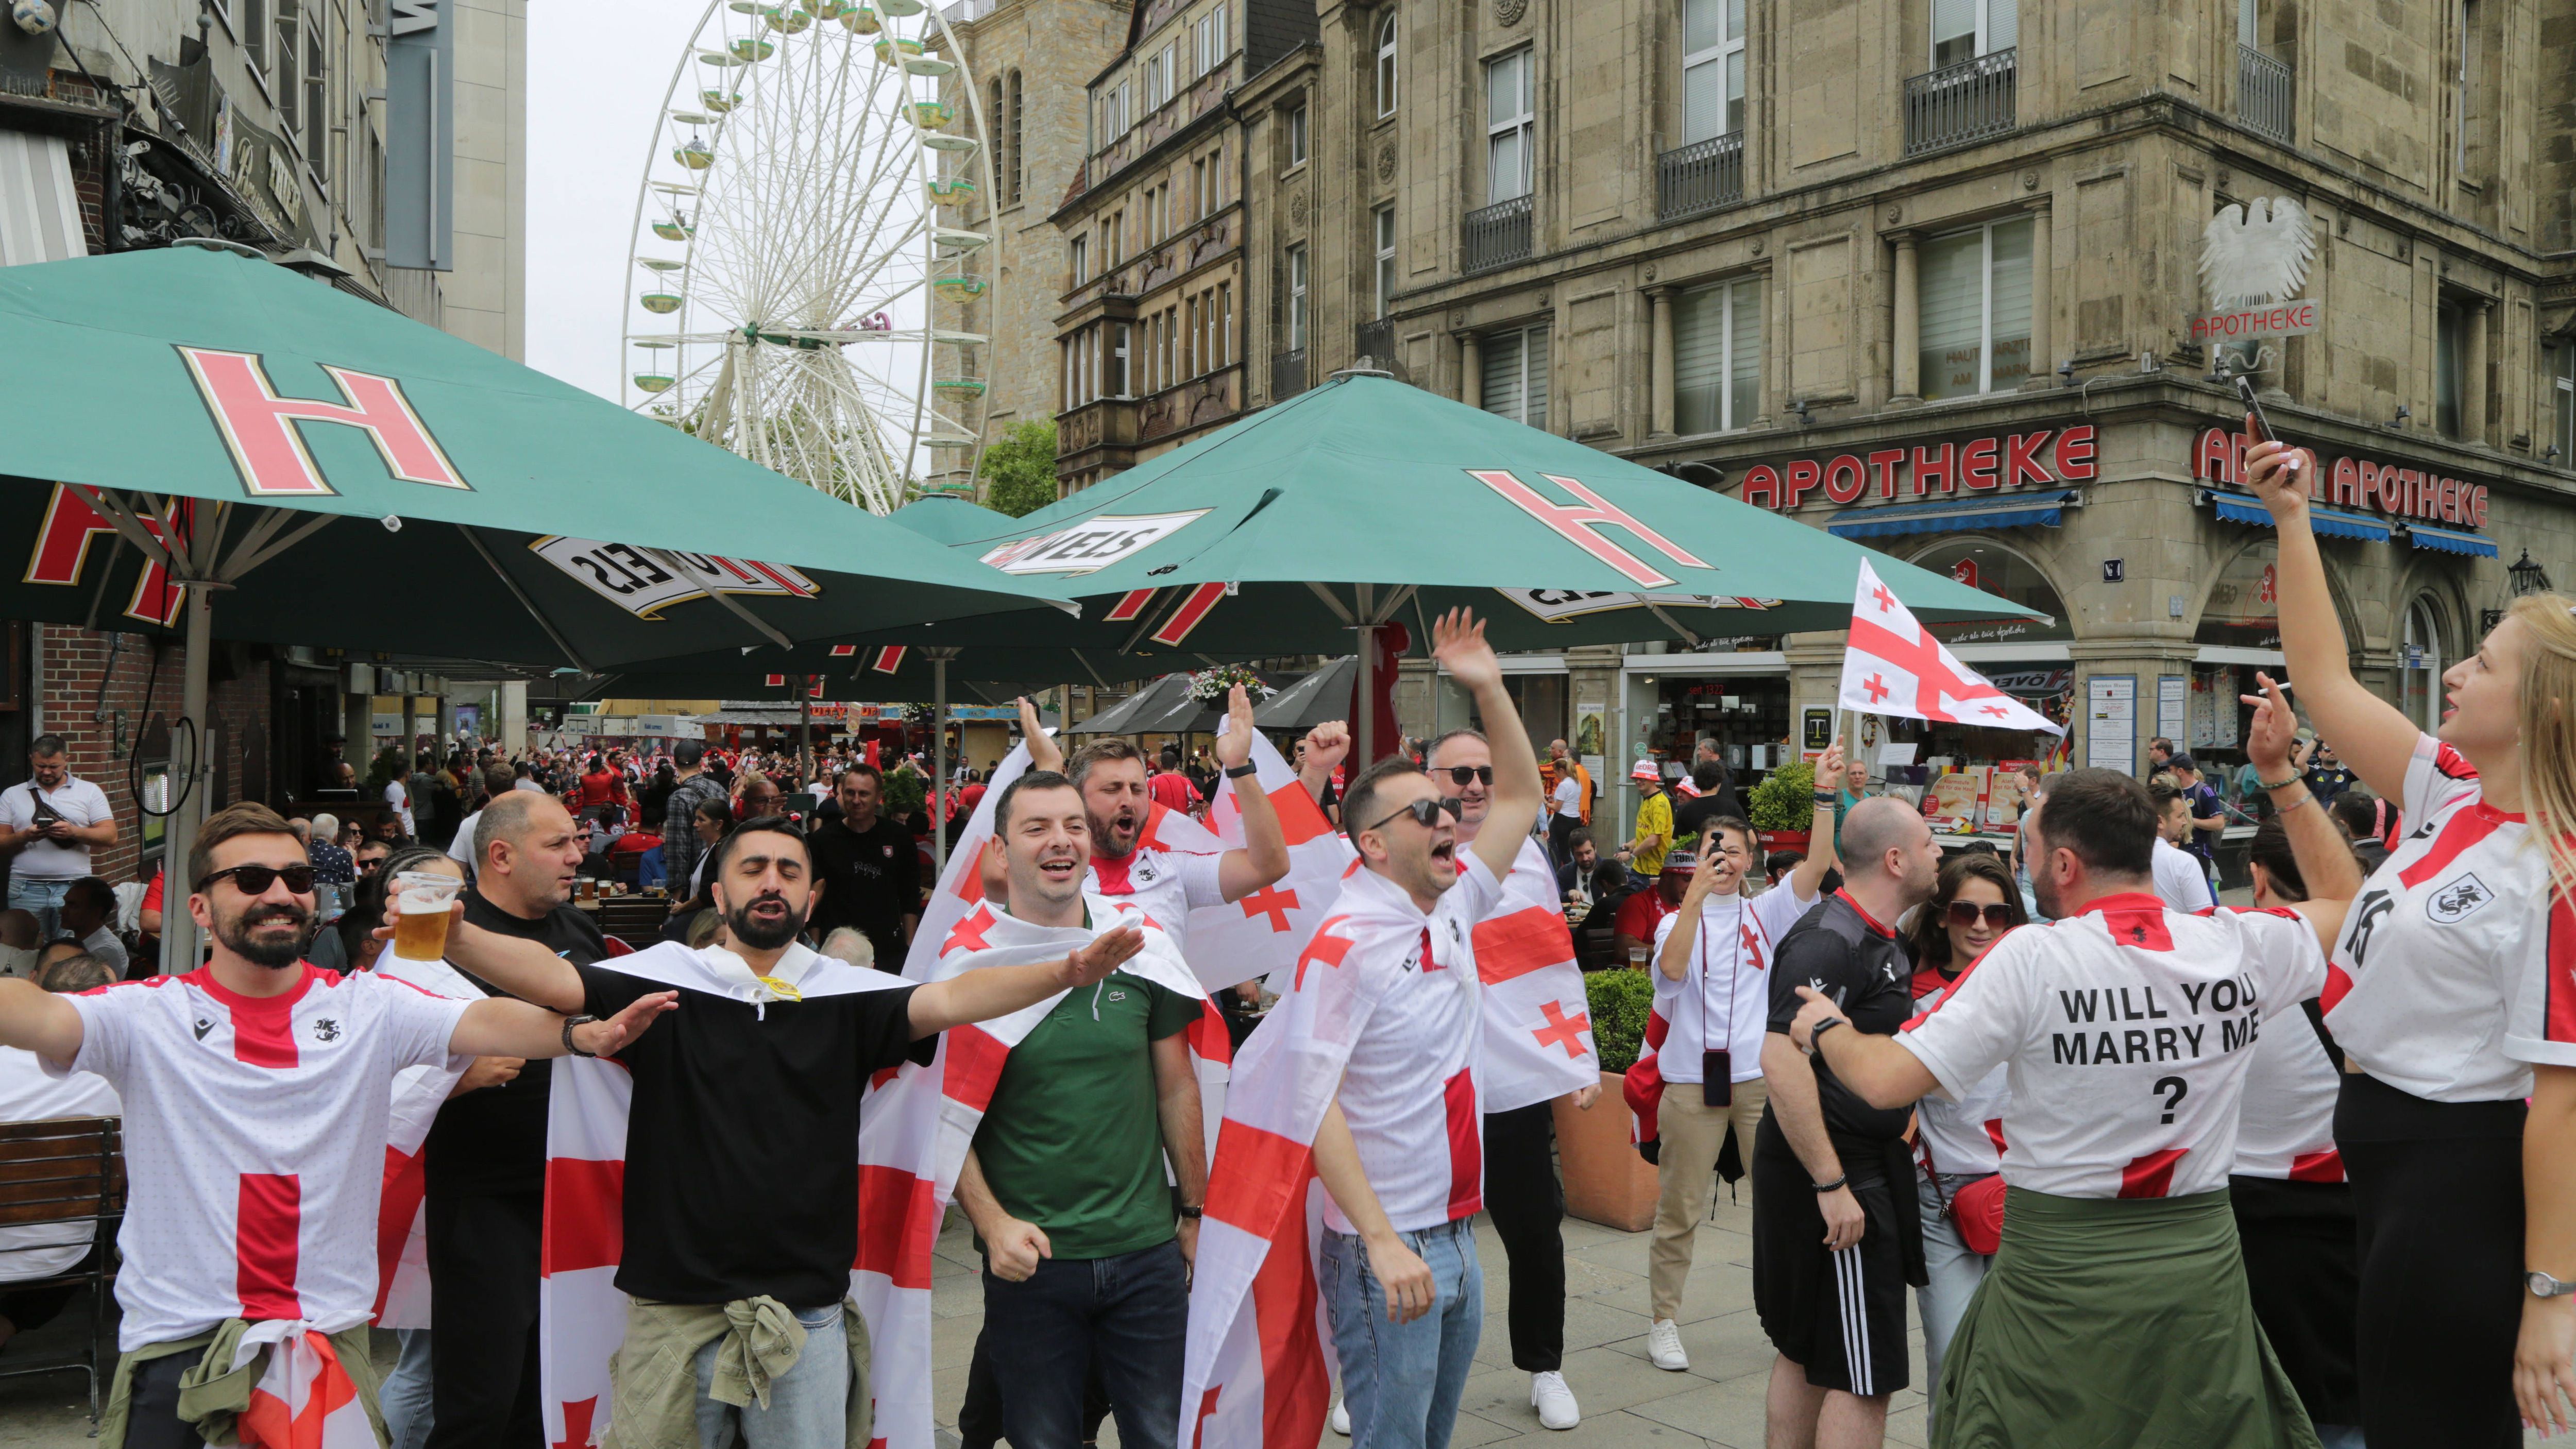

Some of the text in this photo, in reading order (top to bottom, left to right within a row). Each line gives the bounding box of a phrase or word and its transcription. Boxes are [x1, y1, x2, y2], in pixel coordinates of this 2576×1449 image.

[2191, 305, 2313, 338] APOTHEKE
[169, 344, 478, 498] H
[1742, 424, 2099, 510] APOTHEKE
[2325, 456, 2488, 529] APOTHEKE
[1462, 469, 1720, 589] H
[1706, 684, 1724, 695] 1322
[1760, 833, 1774, 842] Jahre
[2059, 973, 2256, 1023] WILL YOU
[2052, 1007, 2259, 1065] MARRY ME
[2153, 1076, 2188, 1125] ?
